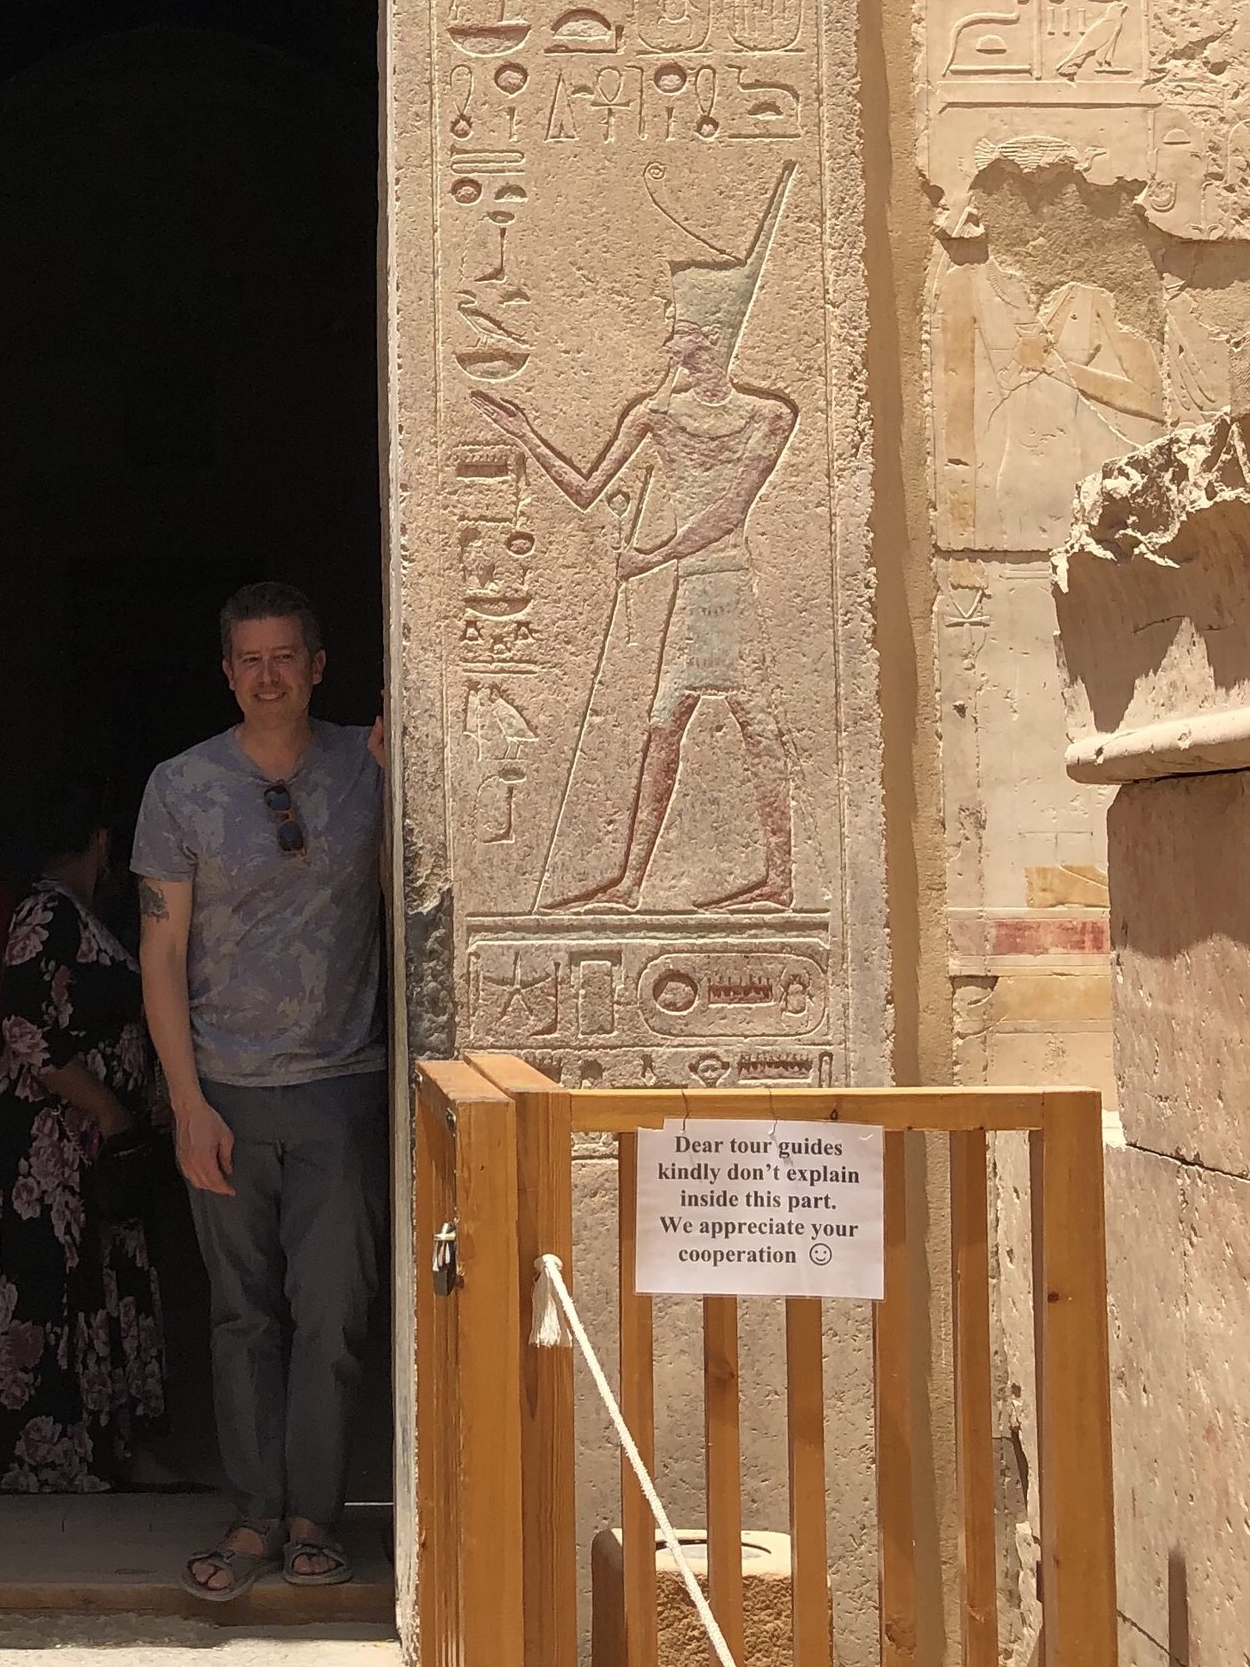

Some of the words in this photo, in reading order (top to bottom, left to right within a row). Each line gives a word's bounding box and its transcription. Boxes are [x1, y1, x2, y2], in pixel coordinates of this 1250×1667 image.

[676, 1136, 723, 1153] Dear
[730, 1139, 772, 1153] tour
[779, 1138, 842, 1159] guides
[659, 1163, 720, 1184] kindly
[728, 1164, 779, 1180] don’t
[787, 1166, 859, 1186] explain
[681, 1190, 738, 1207] inside
[746, 1191, 780, 1207] this
[789, 1194, 836, 1212] part.
[660, 1217, 692, 1233] We
[700, 1218, 804, 1238] appreciate
[811, 1224, 858, 1240] your
[679, 1246, 796, 1266] cooperation
